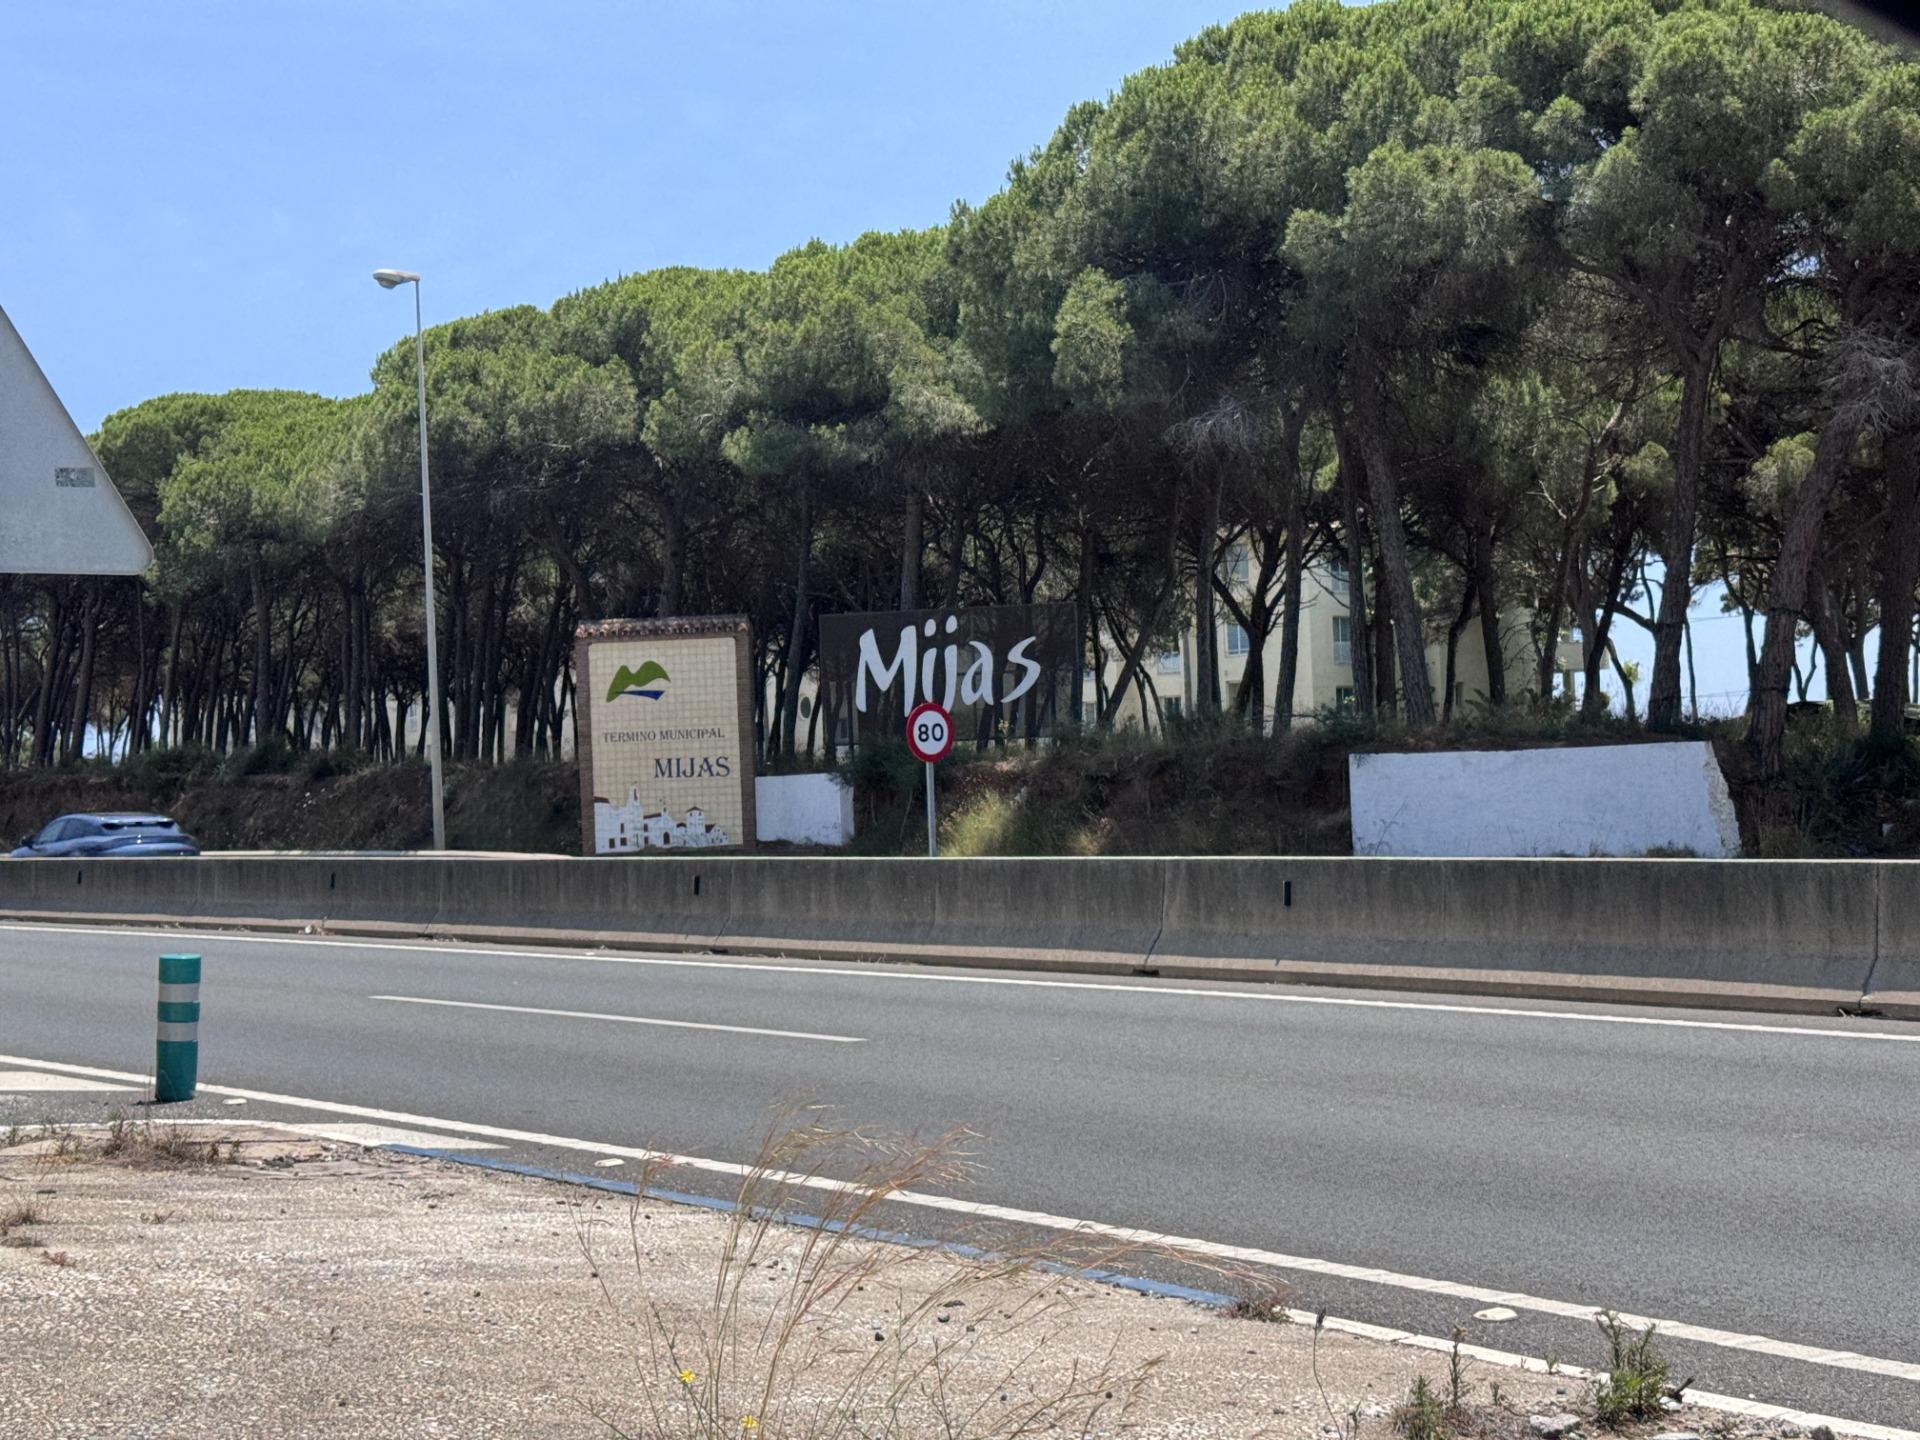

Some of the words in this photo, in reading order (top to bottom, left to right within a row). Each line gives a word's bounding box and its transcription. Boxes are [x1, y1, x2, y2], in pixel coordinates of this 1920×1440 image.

[855, 615, 1041, 718] Mijas
[603, 730, 656, 743] TERMINO
[659, 727, 725, 741] MUNICIPAL
[917, 723, 944, 742] 80
[654, 756, 731, 778] MIJAS
